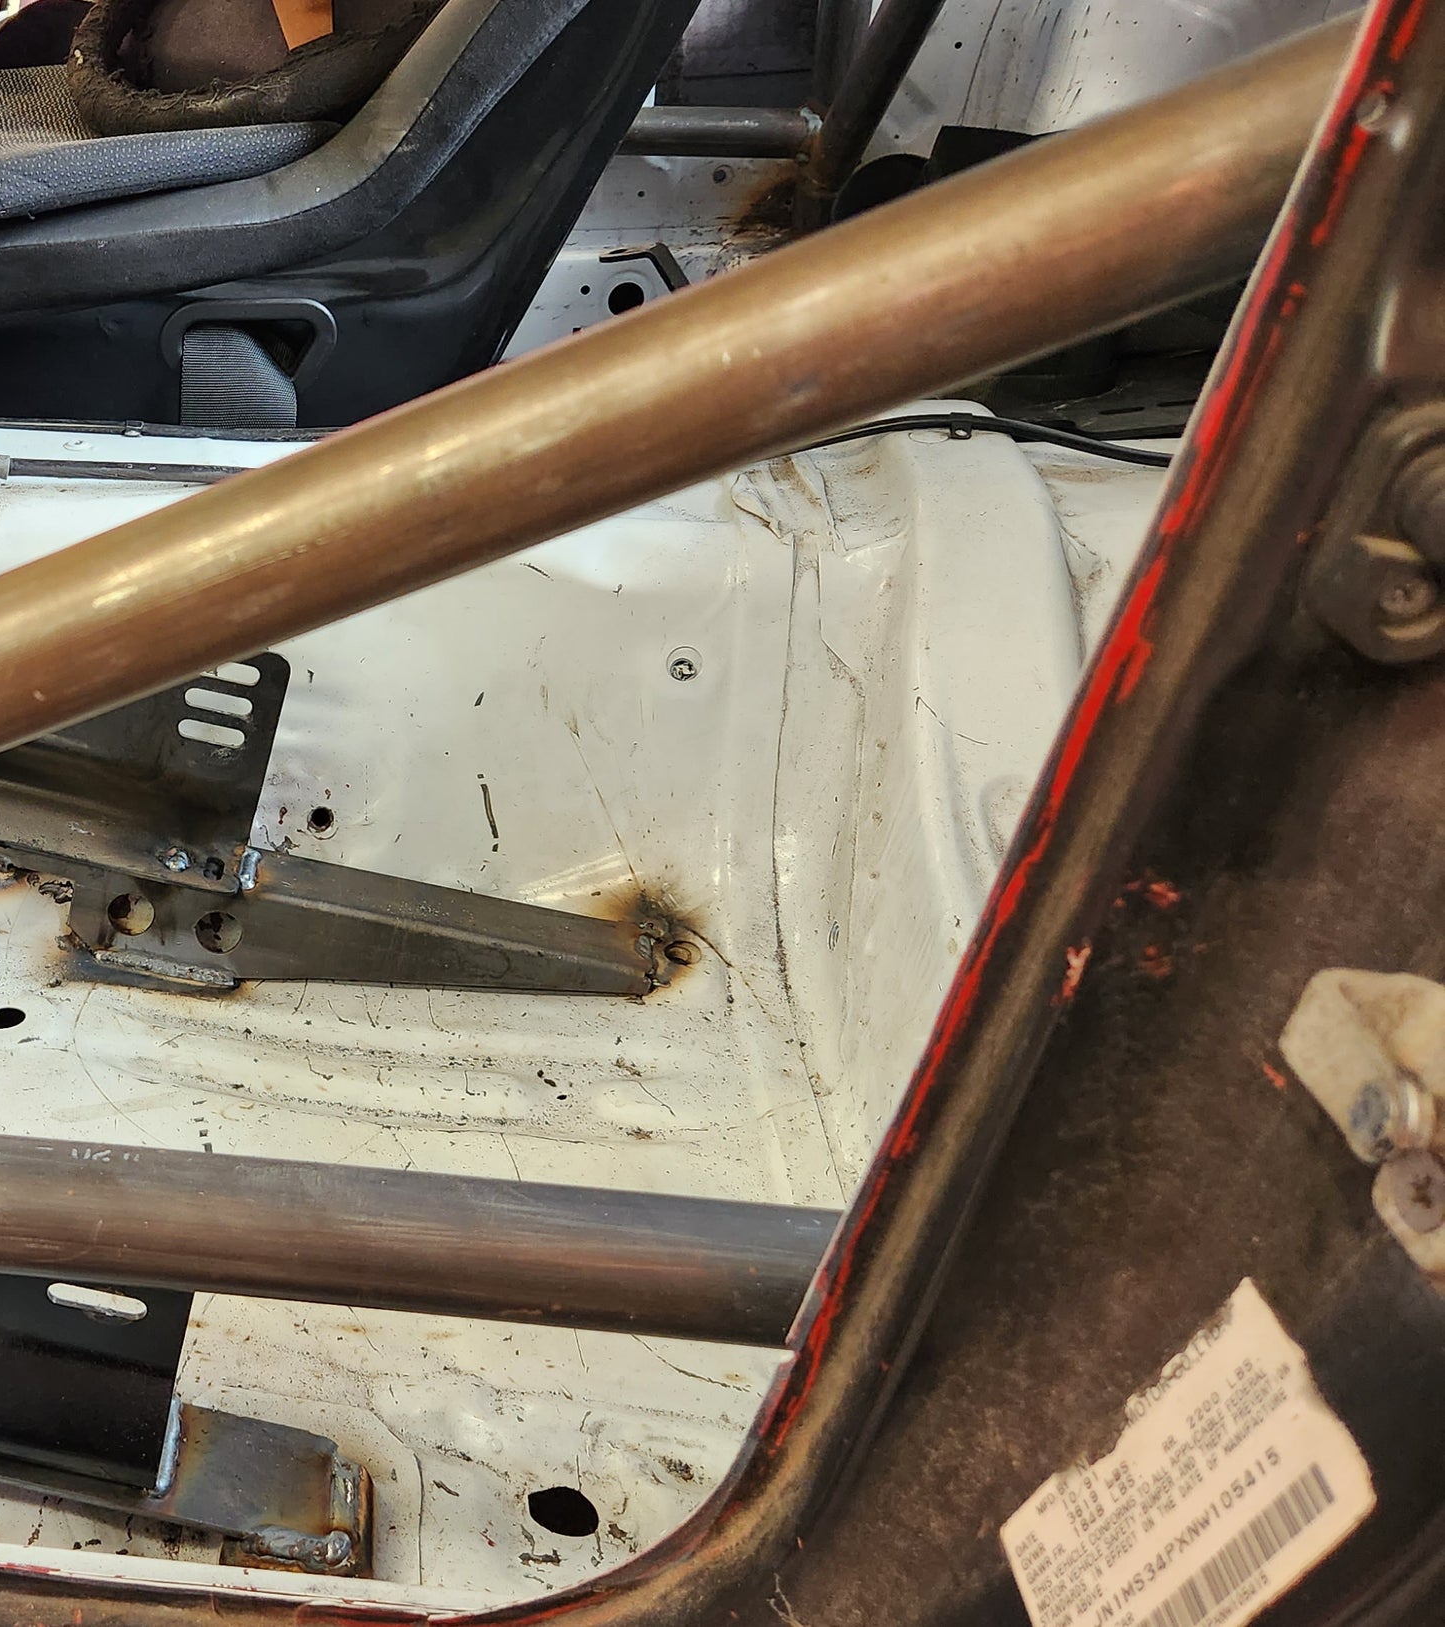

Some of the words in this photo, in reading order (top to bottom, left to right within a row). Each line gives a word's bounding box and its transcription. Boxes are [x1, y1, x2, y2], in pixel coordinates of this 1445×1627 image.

[1015, 1530, 1037, 1557] DATE
[1020, 1542, 1045, 1570] GVWR
[1026, 1555, 1051, 1584] GAWR
[1074, 1503, 1104, 1537] 1848
[1161, 1433, 1176, 1452] RR
[1186, 1390, 1220, 1429] 2200
[1033, 1574, 1053, 1599] THIS
[1053, 1541, 1087, 1579] VEHICLE
[1088, 1493, 1136, 1545] CONFORMS
[1137, 1480, 1150, 1498] TO
[1150, 1464, 1166, 1485] ALL
[1167, 1407, 1223, 1468] APPLICABLE
[1224, 1367, 1265, 1411] FEDERAL
[1036, 1579, 1067, 1613] MOTOR
[1068, 1543, 1103, 1583] VEHICLE
[1177, 1454, 1195, 1478] AND
[1200, 1421, 1229, 1456] THEFT
[1041, 1578, 1087, 1627] STANDARDS
[1091, 1564, 1102, 1580] IN
[1105, 1530, 1138, 1568] EFFECT
[1141, 1514, 1154, 1532] ON
[1157, 1494, 1175, 1517] THE
[1178, 1468, 1202, 1497] DATE
[1205, 1451, 1219, 1470] OF
